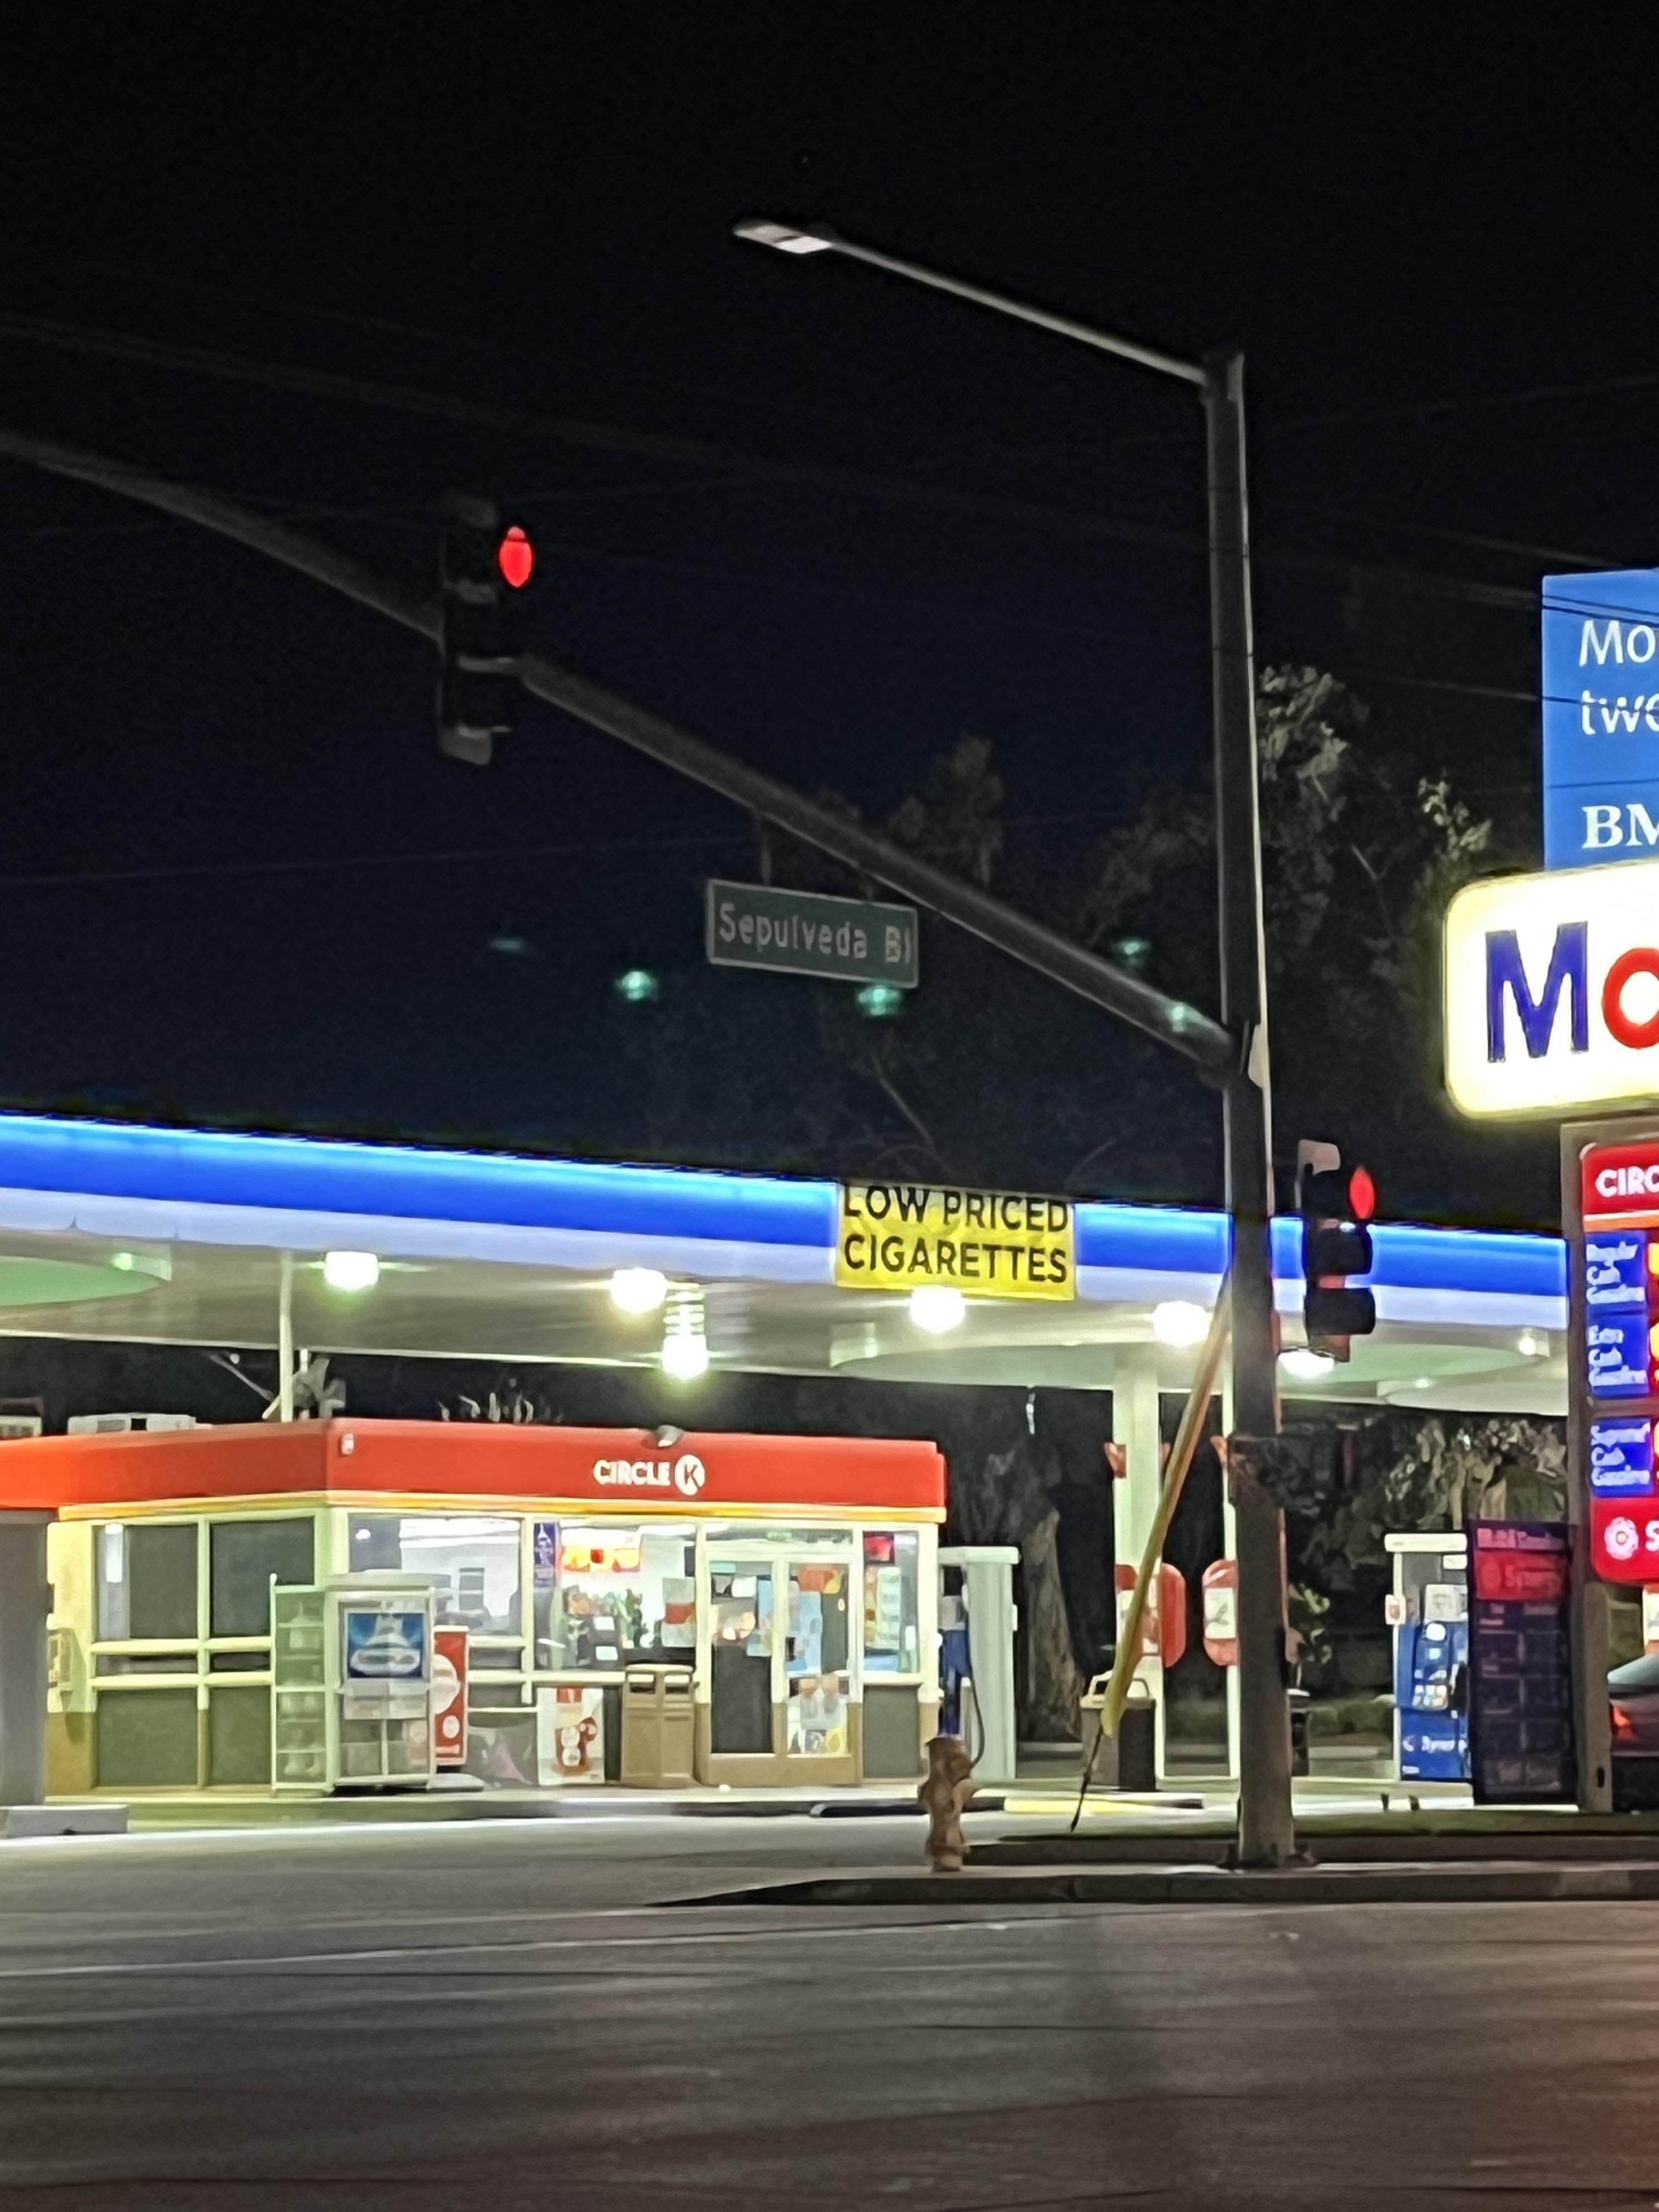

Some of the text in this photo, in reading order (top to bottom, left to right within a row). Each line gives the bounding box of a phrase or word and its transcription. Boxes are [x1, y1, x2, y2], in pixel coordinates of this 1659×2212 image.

[719, 902, 911, 964] Sepulveda Bl
[844, 1185, 1068, 1232] LOW PRICED
[844, 1234, 1066, 1283] CIGARETTES
[594, 1459, 671, 1487] CIRCLE
